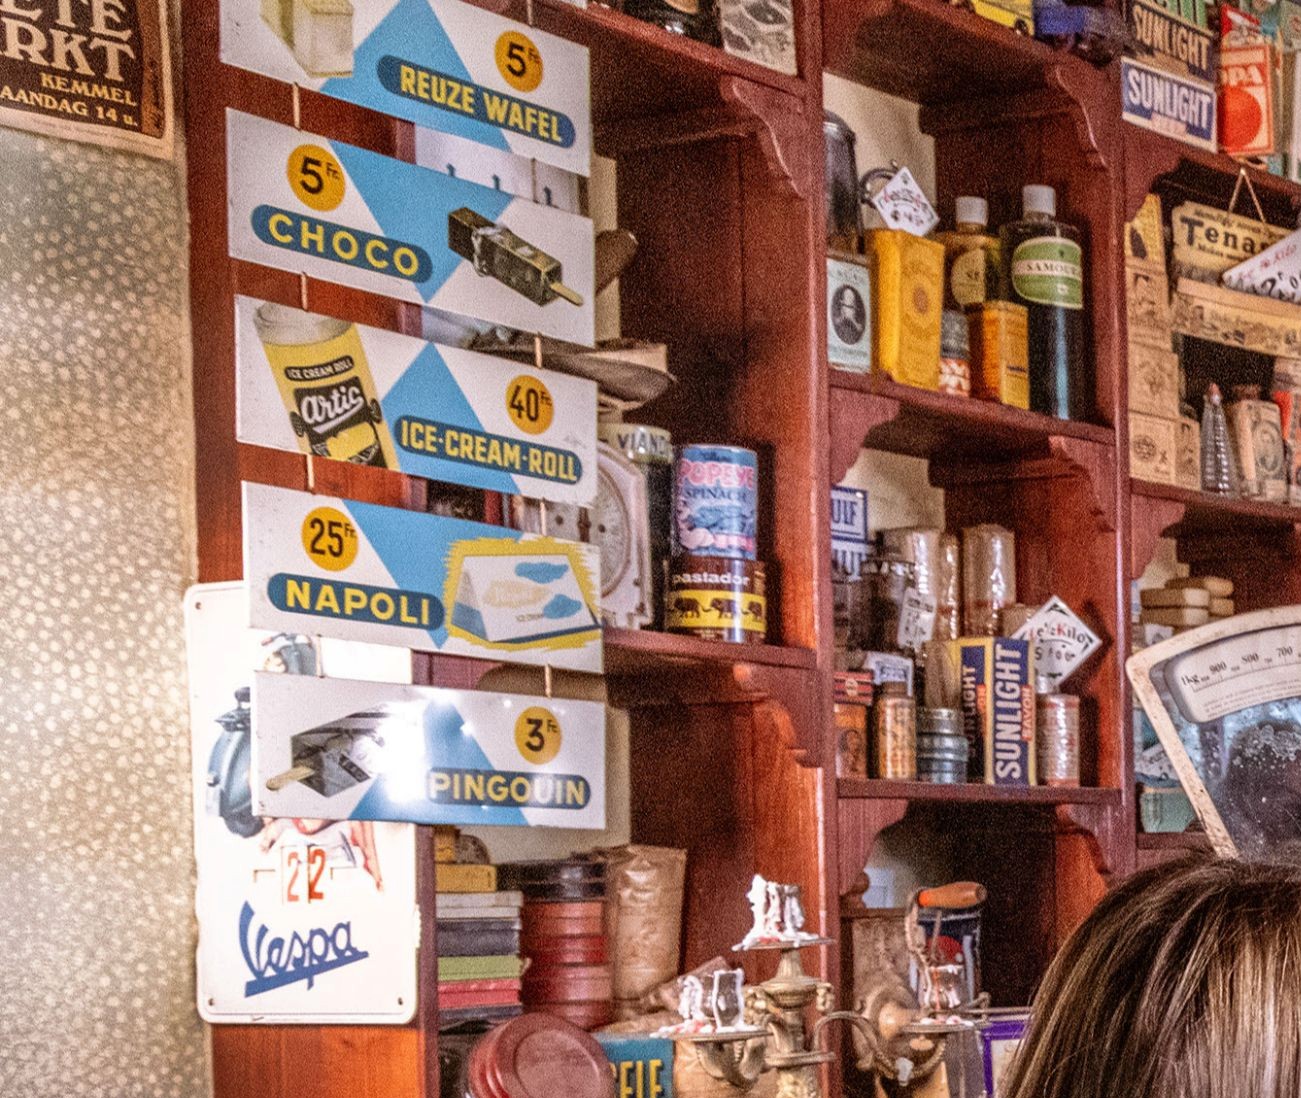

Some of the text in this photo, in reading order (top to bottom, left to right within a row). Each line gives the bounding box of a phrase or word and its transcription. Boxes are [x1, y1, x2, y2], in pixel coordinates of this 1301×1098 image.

[1133, 5, 1210, 71] SUNLIGHT
[506, 41, 526, 77] 5
[40, 72, 138, 107] KEMMEL
[400, 65, 564, 143] REUZE WAFEL
[1127, 68, 1211, 129] SUNLIGHT
[95, 106, 118, 122] 14
[300, 156, 324, 195] 5
[268, 212, 420, 278] CHOCO
[287, 367, 302, 379] ICE
[302, 364, 334, 379] CREAM
[301, 386, 364, 427] artic
[510, 384, 538, 422] 40
[310, 517, 344, 558] 25
[286, 578, 430, 625] NAPOLI
[1056, 623, 1086, 642] Kilo
[1209, 662, 1227, 674] 900
[1241, 653, 1260, 664] 800
[1277, 646, 1294, 658] 700
[995, 644, 1022, 779] SUNLIGHT
[1022, 686, 1032, 739] SAVON
[525, 718, 545, 752] 3
[429, 771, 586, 806] PINGOUIN
[239, 900, 370, 998] Vespa
